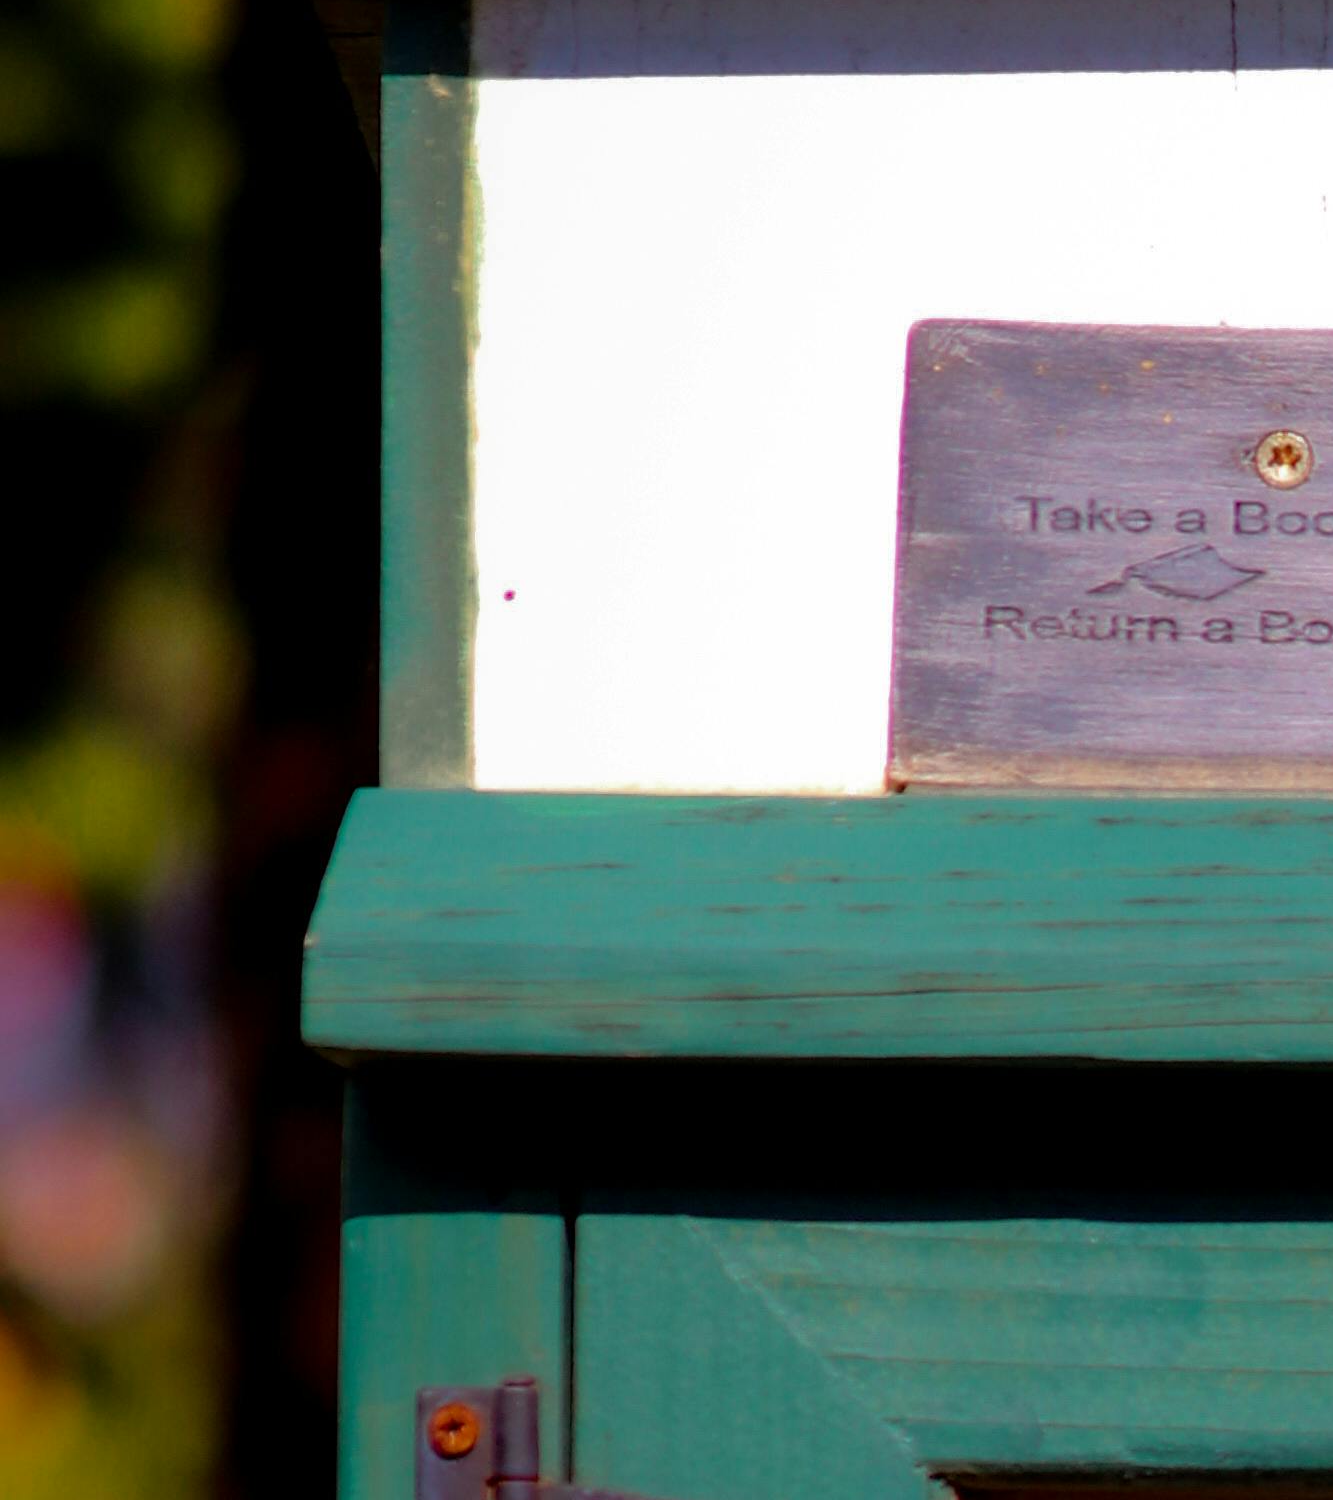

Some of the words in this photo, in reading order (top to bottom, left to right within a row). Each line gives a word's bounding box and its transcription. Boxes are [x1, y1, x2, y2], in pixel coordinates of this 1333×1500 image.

[1021, 497, 1155, 538] Take
[1173, 506, 1209, 537] a
[982, 605, 1180, 644] Return
[1199, 612, 1235, 646] a
